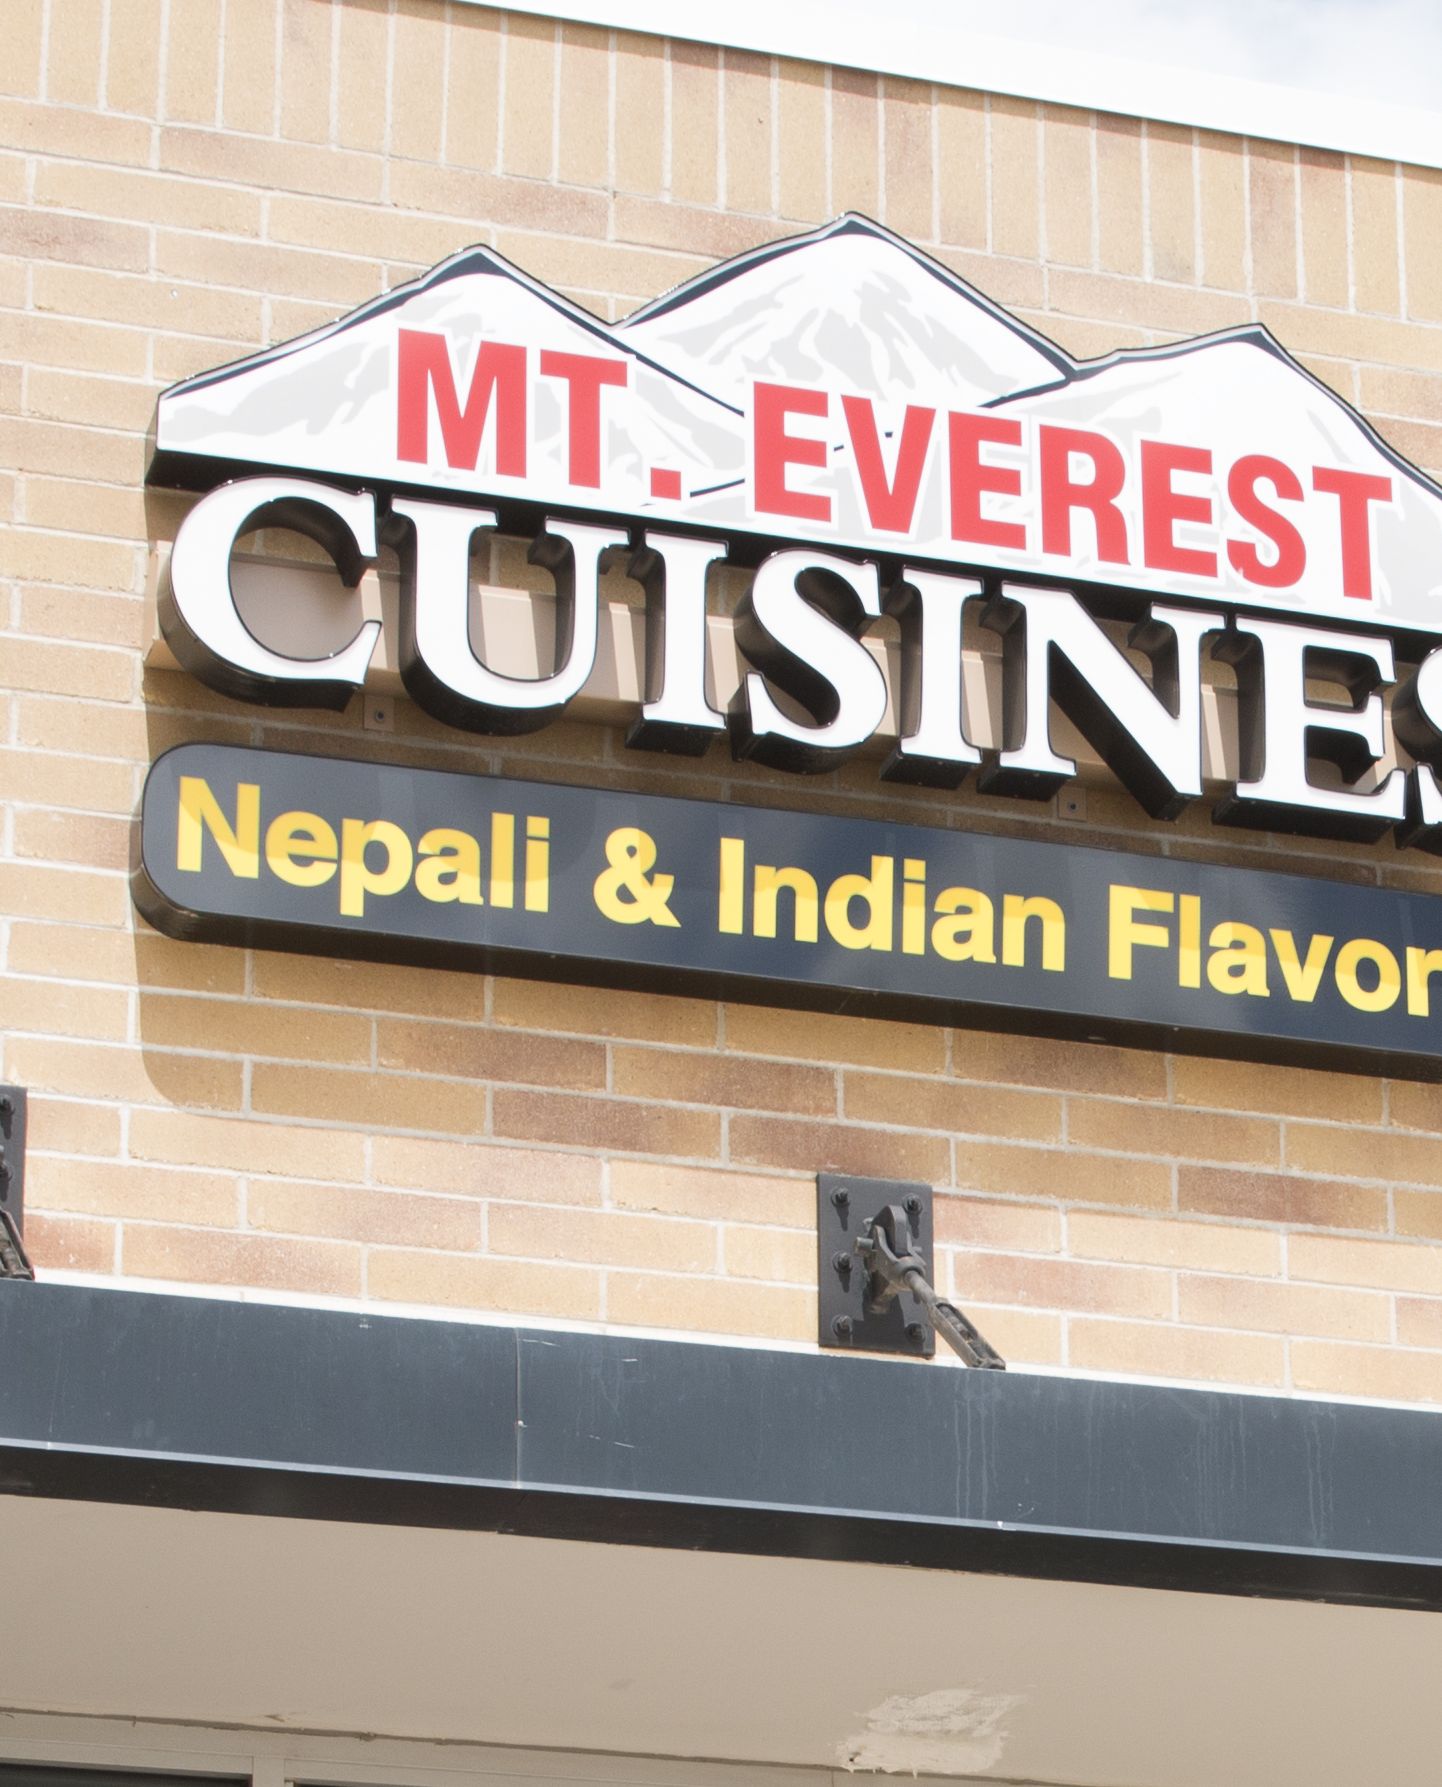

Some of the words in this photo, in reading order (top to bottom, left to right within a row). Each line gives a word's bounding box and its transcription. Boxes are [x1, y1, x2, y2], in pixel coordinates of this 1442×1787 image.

[397, 327, 690, 501] MT.
[749, 379, 1393, 602] EVEREST
[175, 774, 551, 917] Nepali
[593, 826, 682, 928] &
[717, 835, 1067, 971] Indian
